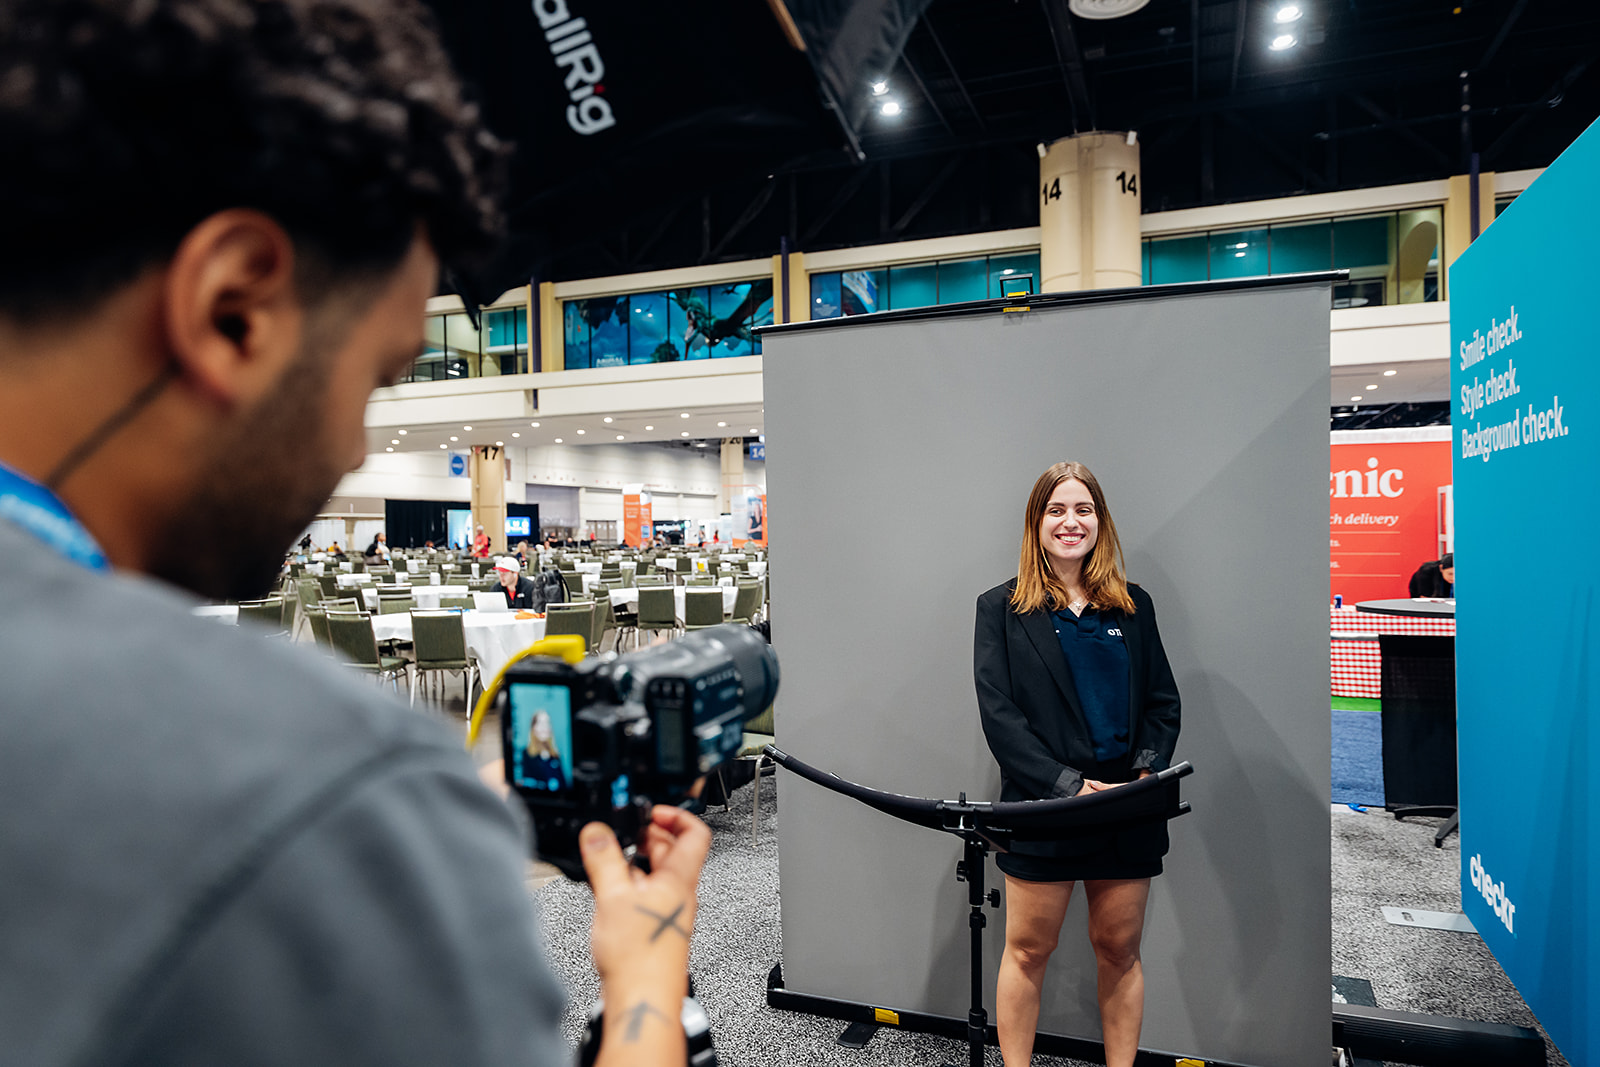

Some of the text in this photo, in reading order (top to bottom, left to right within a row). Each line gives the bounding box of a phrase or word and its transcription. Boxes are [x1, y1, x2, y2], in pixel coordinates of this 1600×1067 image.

[1042, 177, 1062, 206] 14
[1115, 171, 1137, 197] 14
[1460, 305, 1522, 371] Smile check.
[1461, 359, 1520, 420] Style check.
[1462, 395, 1568, 463] Background check.
[481, 446, 499, 460] 17
[1330, 457, 1404, 498] nic
[1344, 513, 1399, 527] delivery
